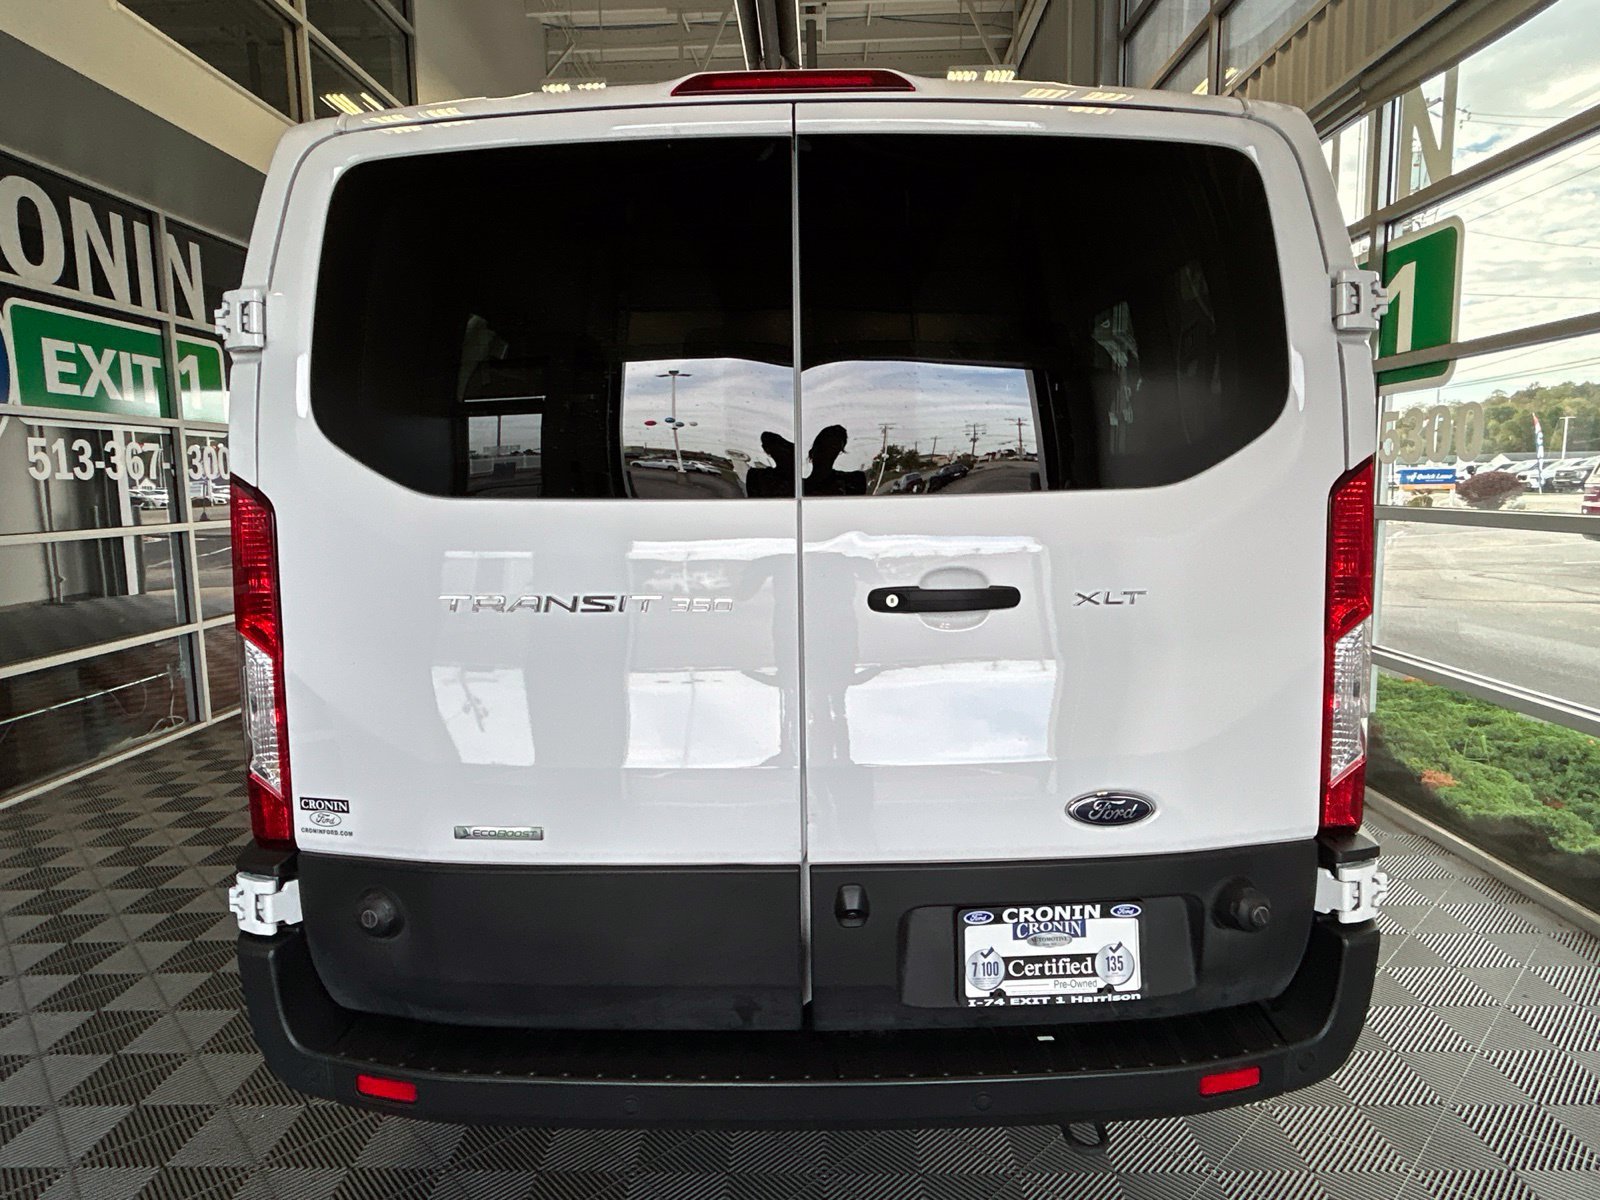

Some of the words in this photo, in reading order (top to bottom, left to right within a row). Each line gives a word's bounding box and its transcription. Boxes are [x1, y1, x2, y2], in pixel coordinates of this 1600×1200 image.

[1385, 261, 1416, 354] 1
[41, 336, 161, 403] EXIT
[177, 354, 202, 409] 1
[27, 437, 229, 481] 513-367-300
[438, 594, 663, 613] TRANSIT
[671, 597, 734, 613] 350
[1073, 590, 1147, 606] XLT
[301, 799, 348, 811] CRONIN
[1088, 799, 1138, 821] Ford
[316, 812, 336, 825] Ford
[301, 827, 353, 836] CRONINFORD.COM
[969, 913, 988, 922] Ford
[1003, 904, 1101, 923] CRONIN
[1117, 906, 1137, 916] Ford
[1016, 920, 1083, 938] CRONIN
[1030, 936, 1069, 944] AUTOMOTIVE
[1008, 956, 1093, 977] Certified
[1105, 955, 1124, 972] 135
[1053, 979, 1098, 989] Pre-Owned
[968, 998, 1005, 1008] I-74
[1010, 996, 1051, 1006] EXIT
[1055, 996, 1065, 1004] 1
[1068, 993, 1141, 1004] Harrison
